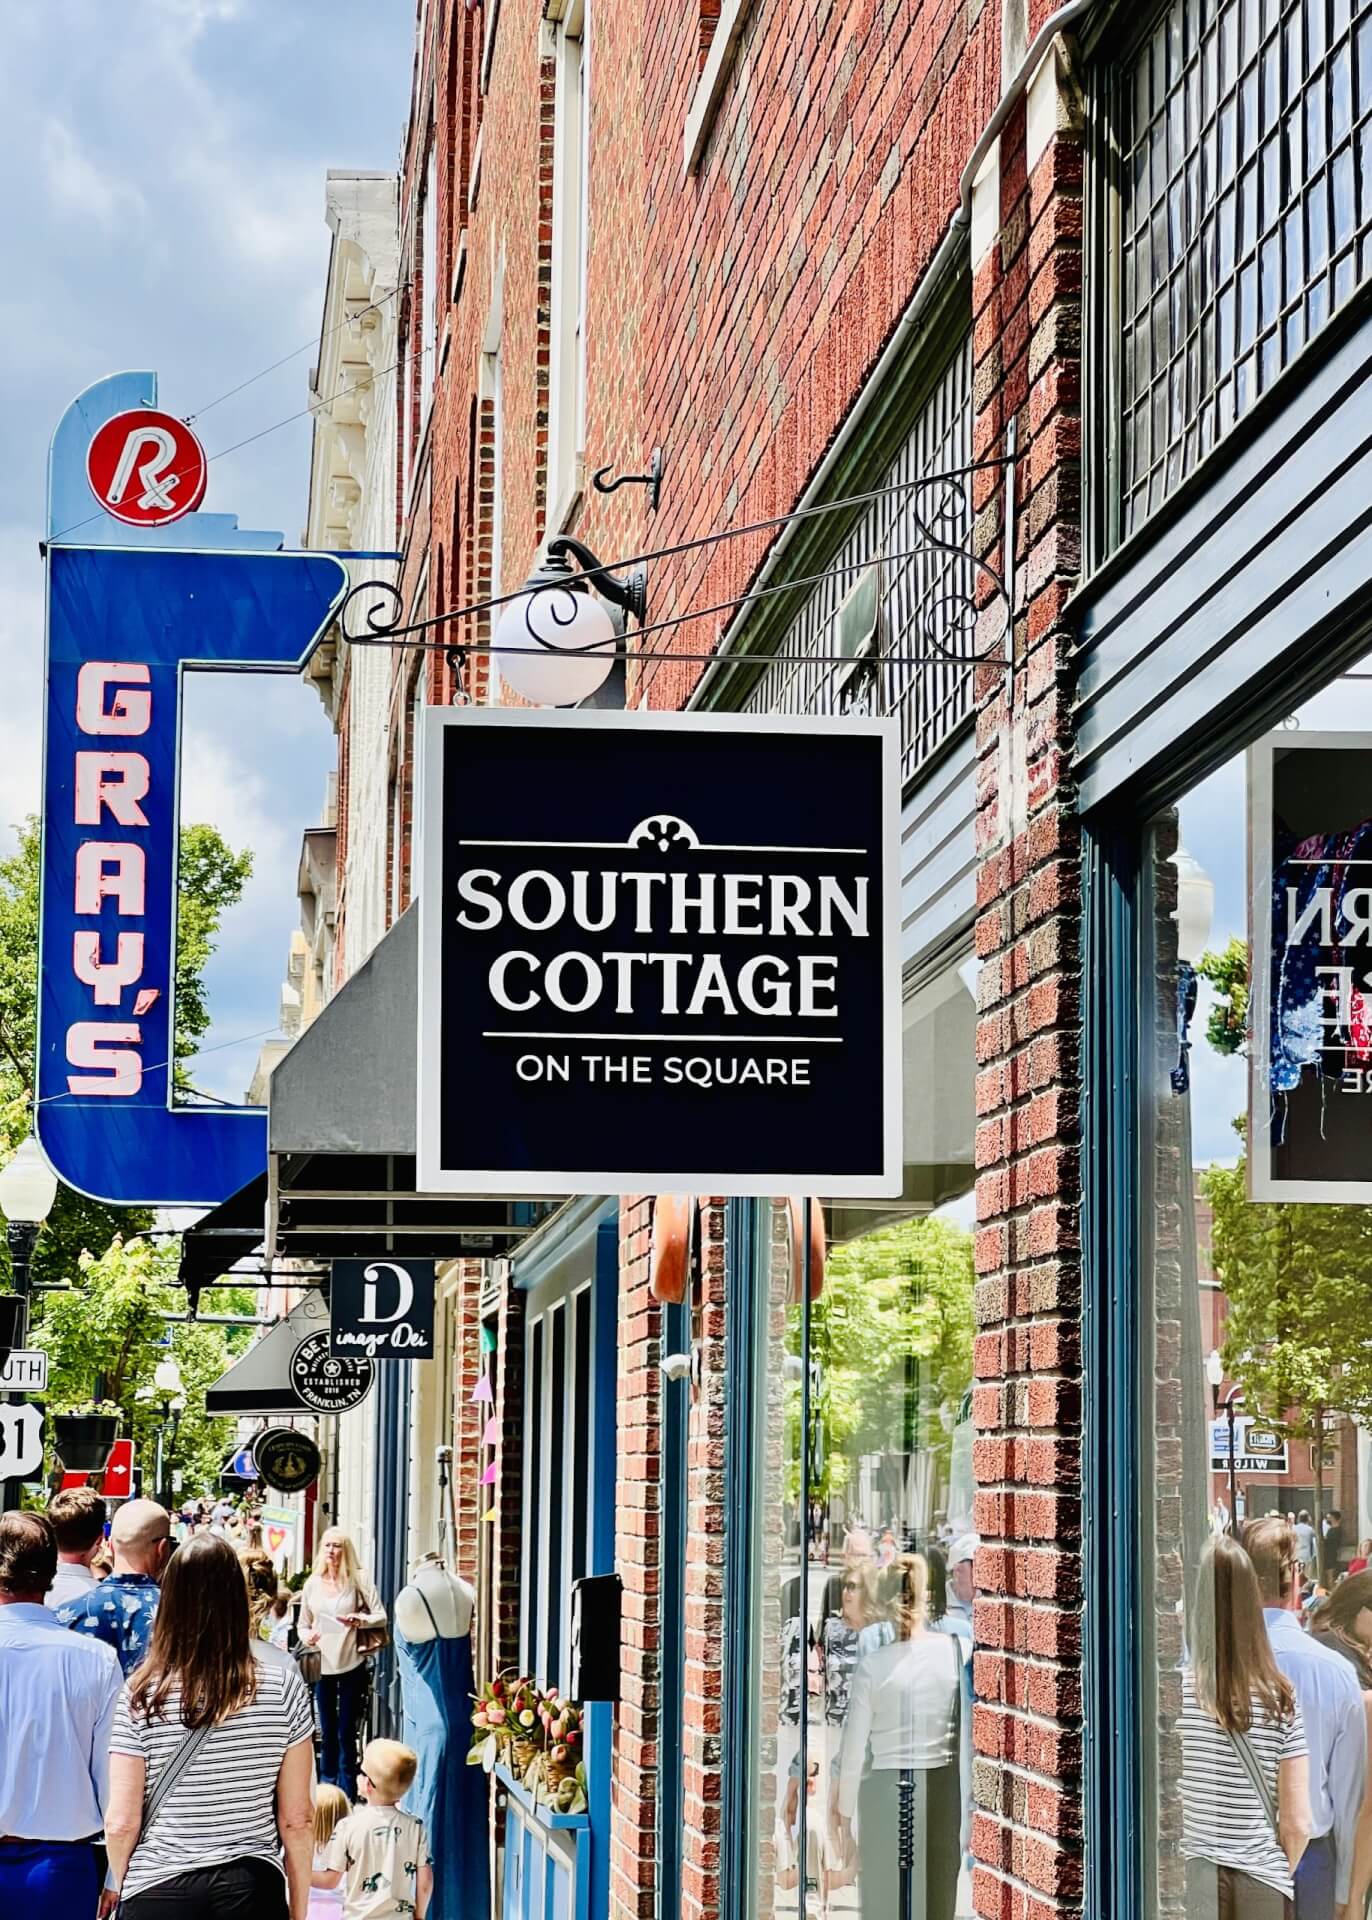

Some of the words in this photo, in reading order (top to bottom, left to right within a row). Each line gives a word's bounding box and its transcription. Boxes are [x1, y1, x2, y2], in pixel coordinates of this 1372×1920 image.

[65, 660, 160, 1098] GRAY'S
[456, 868, 870, 938] SOUTHERN
[488, 949, 840, 1018] COTTAGE
[515, 1054, 570, 1083] ON
[581, 1055, 652, 1084] THE
[662, 1056, 811, 1089] SQUARE
[335, 1328, 390, 1357] imago
[391, 1322, 428, 1348] Dei
[303, 1377, 361, 1386] ESTABLISHED
[347, 1388, 362, 1402] TN
